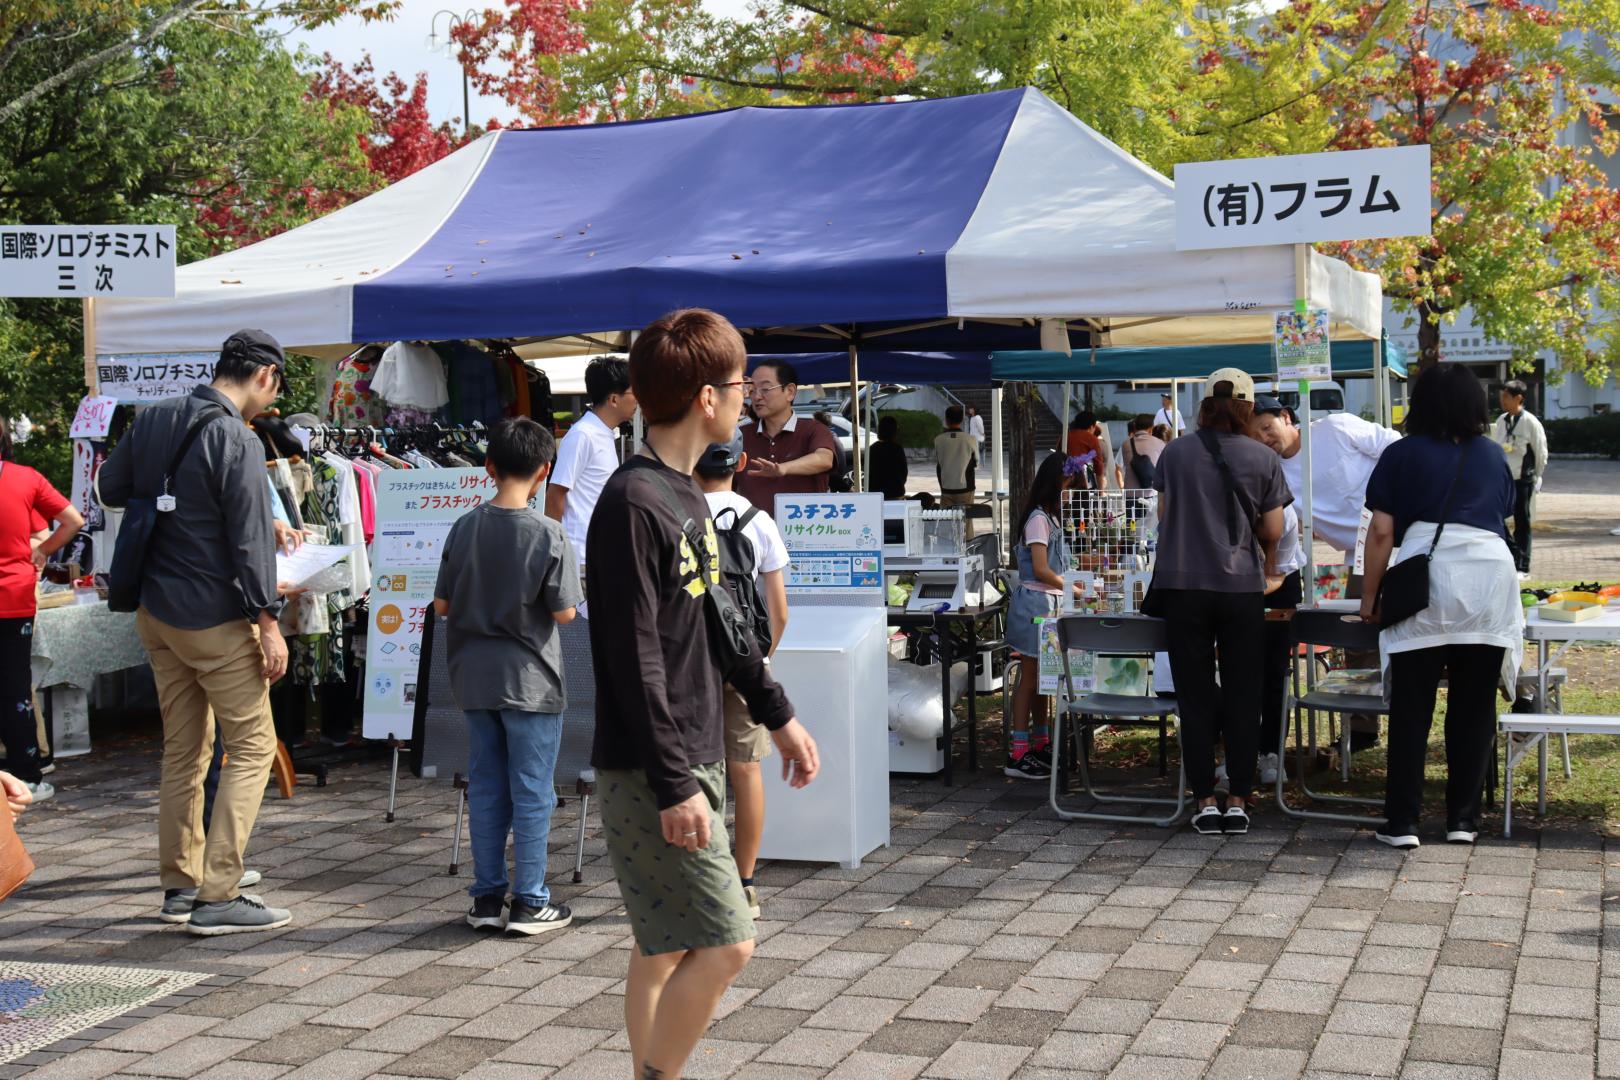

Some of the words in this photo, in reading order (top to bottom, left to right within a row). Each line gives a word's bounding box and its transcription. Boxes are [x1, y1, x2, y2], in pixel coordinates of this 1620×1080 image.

[1203, 175, 1401, 227] (有)フラム
[1, 231, 171, 261] 国際ソロプチミスト
[388, 480, 457, 491] プラスチックはきちんと
[404, 500, 418, 510] また
[419, 494, 482, 509] プラスチック
[784, 503, 857, 520] プチプチ
[784, 523, 836, 536] リサイクル
